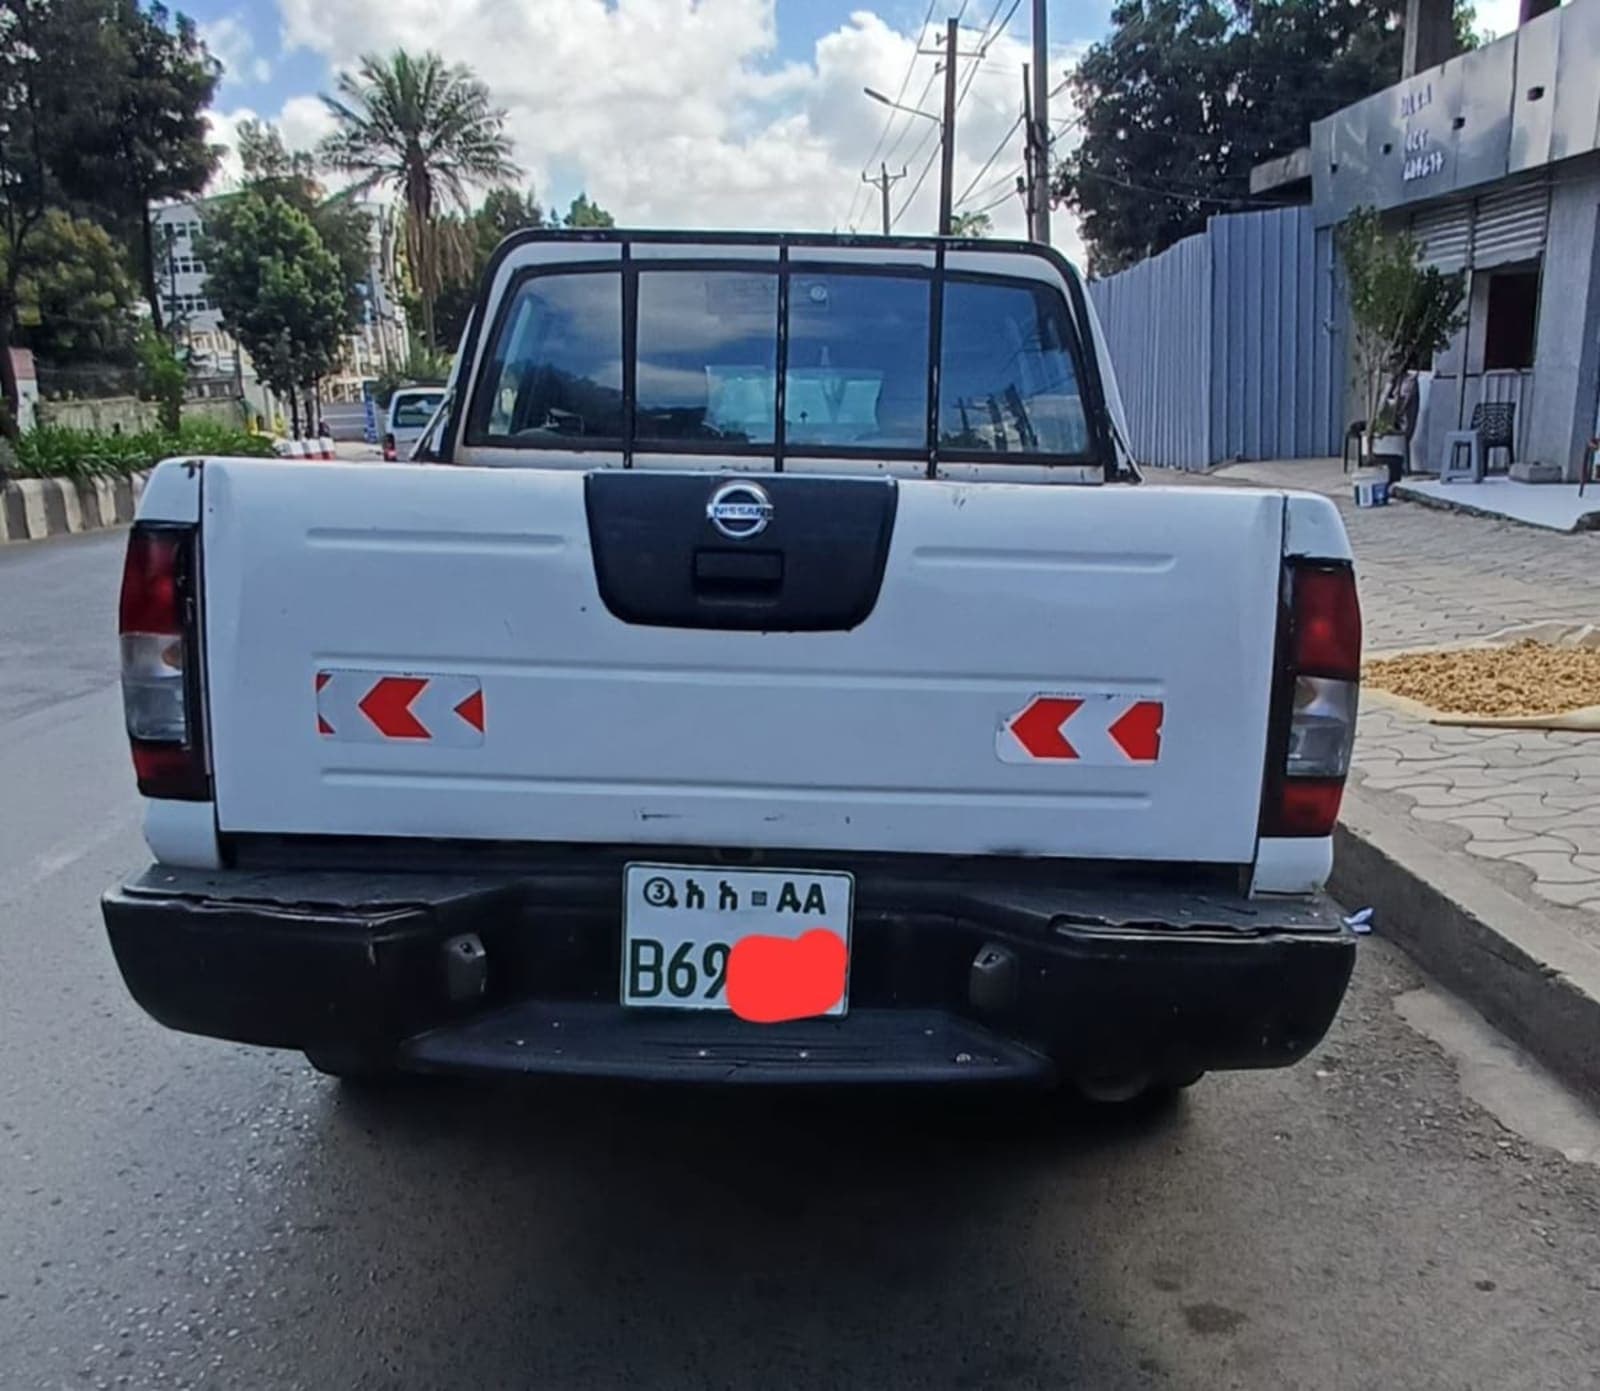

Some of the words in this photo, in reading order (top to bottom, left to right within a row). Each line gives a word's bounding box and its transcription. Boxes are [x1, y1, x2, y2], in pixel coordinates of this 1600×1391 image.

[714, 505, 764, 517] NISSAN
[776, 882, 826, 914] AA
[628, 938, 732, 998] B69
